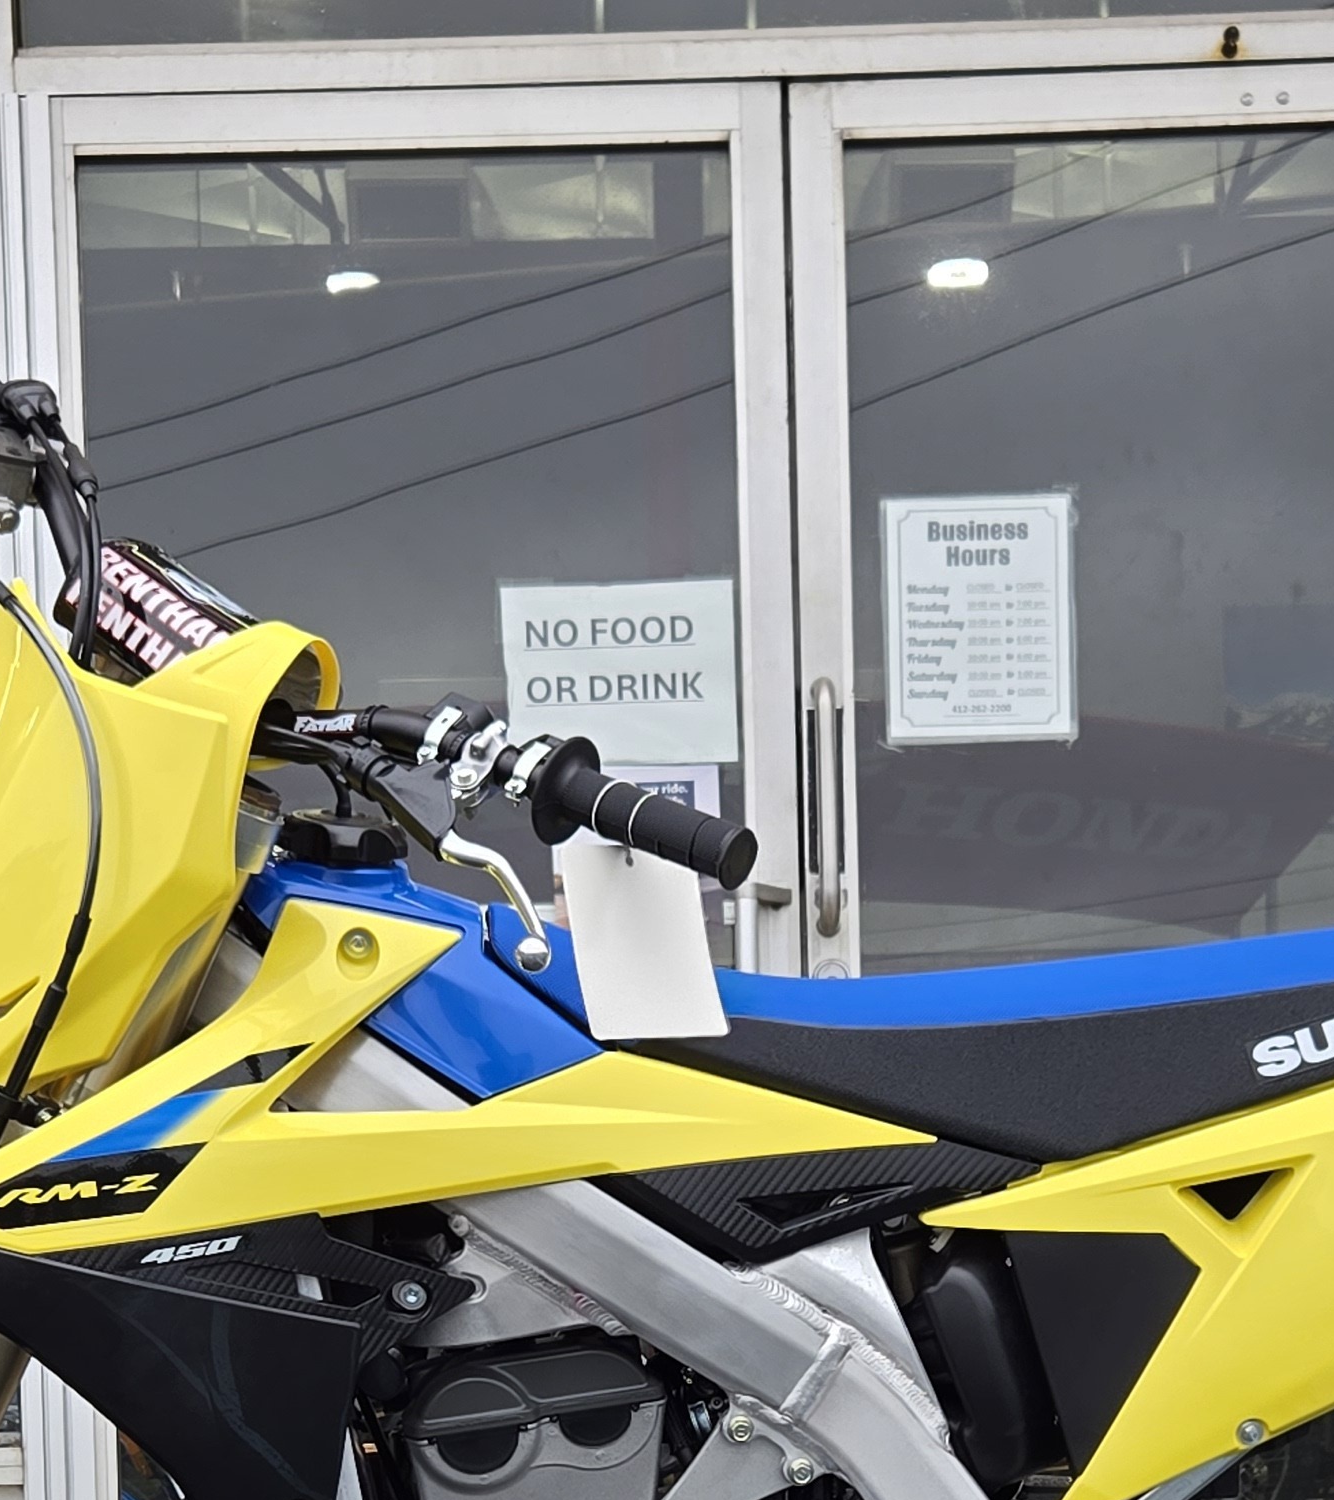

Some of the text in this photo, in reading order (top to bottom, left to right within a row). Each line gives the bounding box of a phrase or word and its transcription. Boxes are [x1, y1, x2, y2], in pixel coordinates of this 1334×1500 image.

[927, 520, 1029, 542] Business
[946, 546, 1011, 567] Hours
[101, 545, 232, 649] RENTHA
[525, 615, 694, 647] NO FOOD
[527, 671, 704, 703] OR DRINK
[140, 1235, 243, 1265] 450
